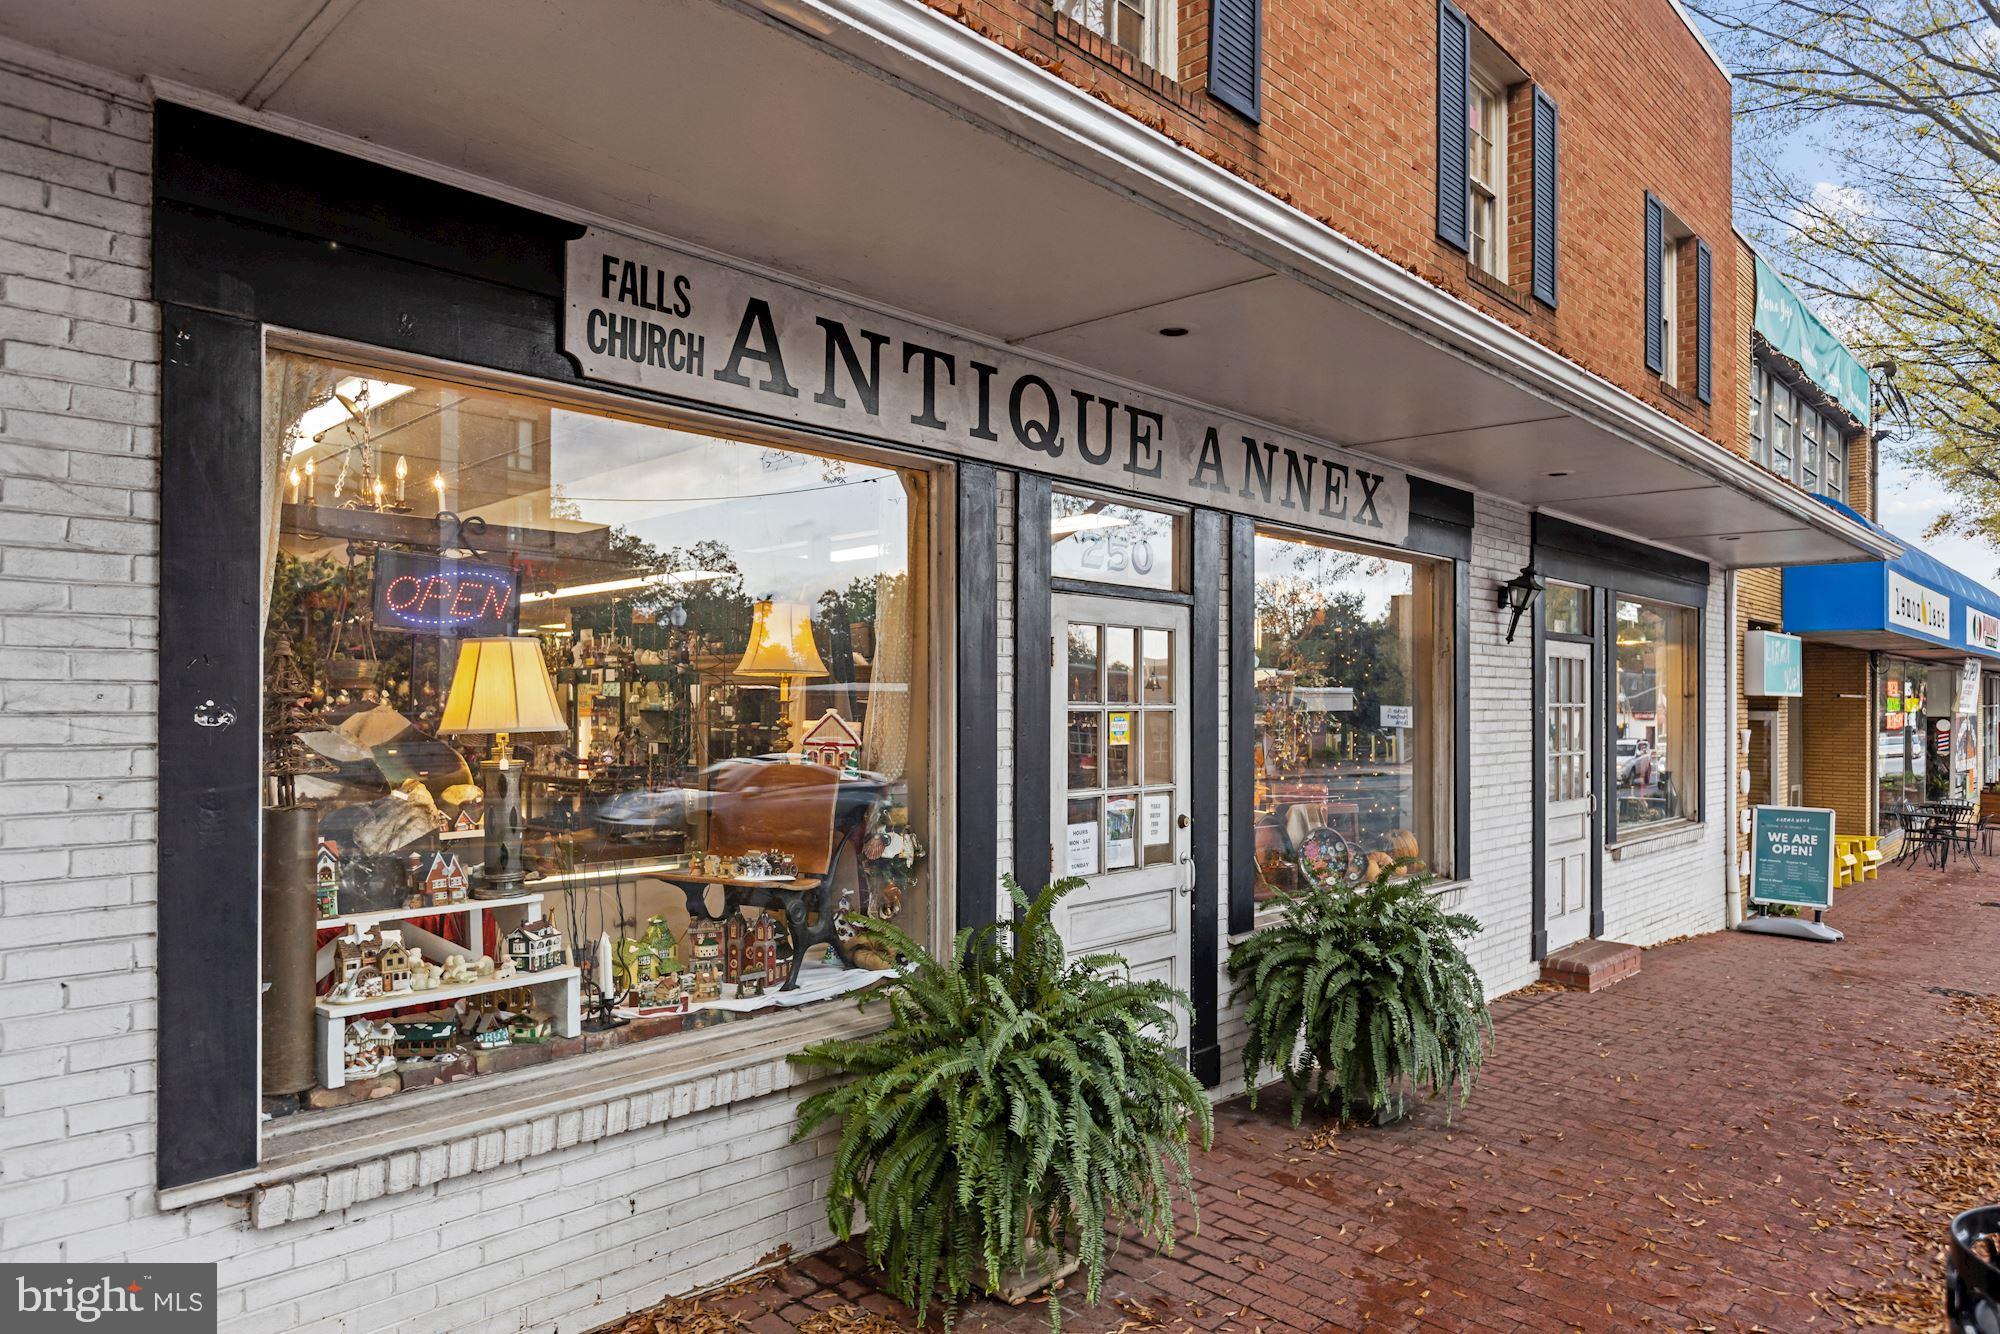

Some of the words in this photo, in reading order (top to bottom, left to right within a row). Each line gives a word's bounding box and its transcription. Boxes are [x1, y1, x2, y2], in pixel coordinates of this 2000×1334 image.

[601, 253, 692, 319] FALLS
[586, 308, 705, 377] CHURCH
[713, 297, 1163, 480] ANTIQUE
[1188, 426, 1385, 529] ANNEX
[1080, 532, 1154, 576] 250
[386, 575, 513, 620] OPEN
[1768, 832, 1788, 843] WE
[1792, 834, 1818, 845] ARE
[1772, 844, 1812, 856] OPEN!
